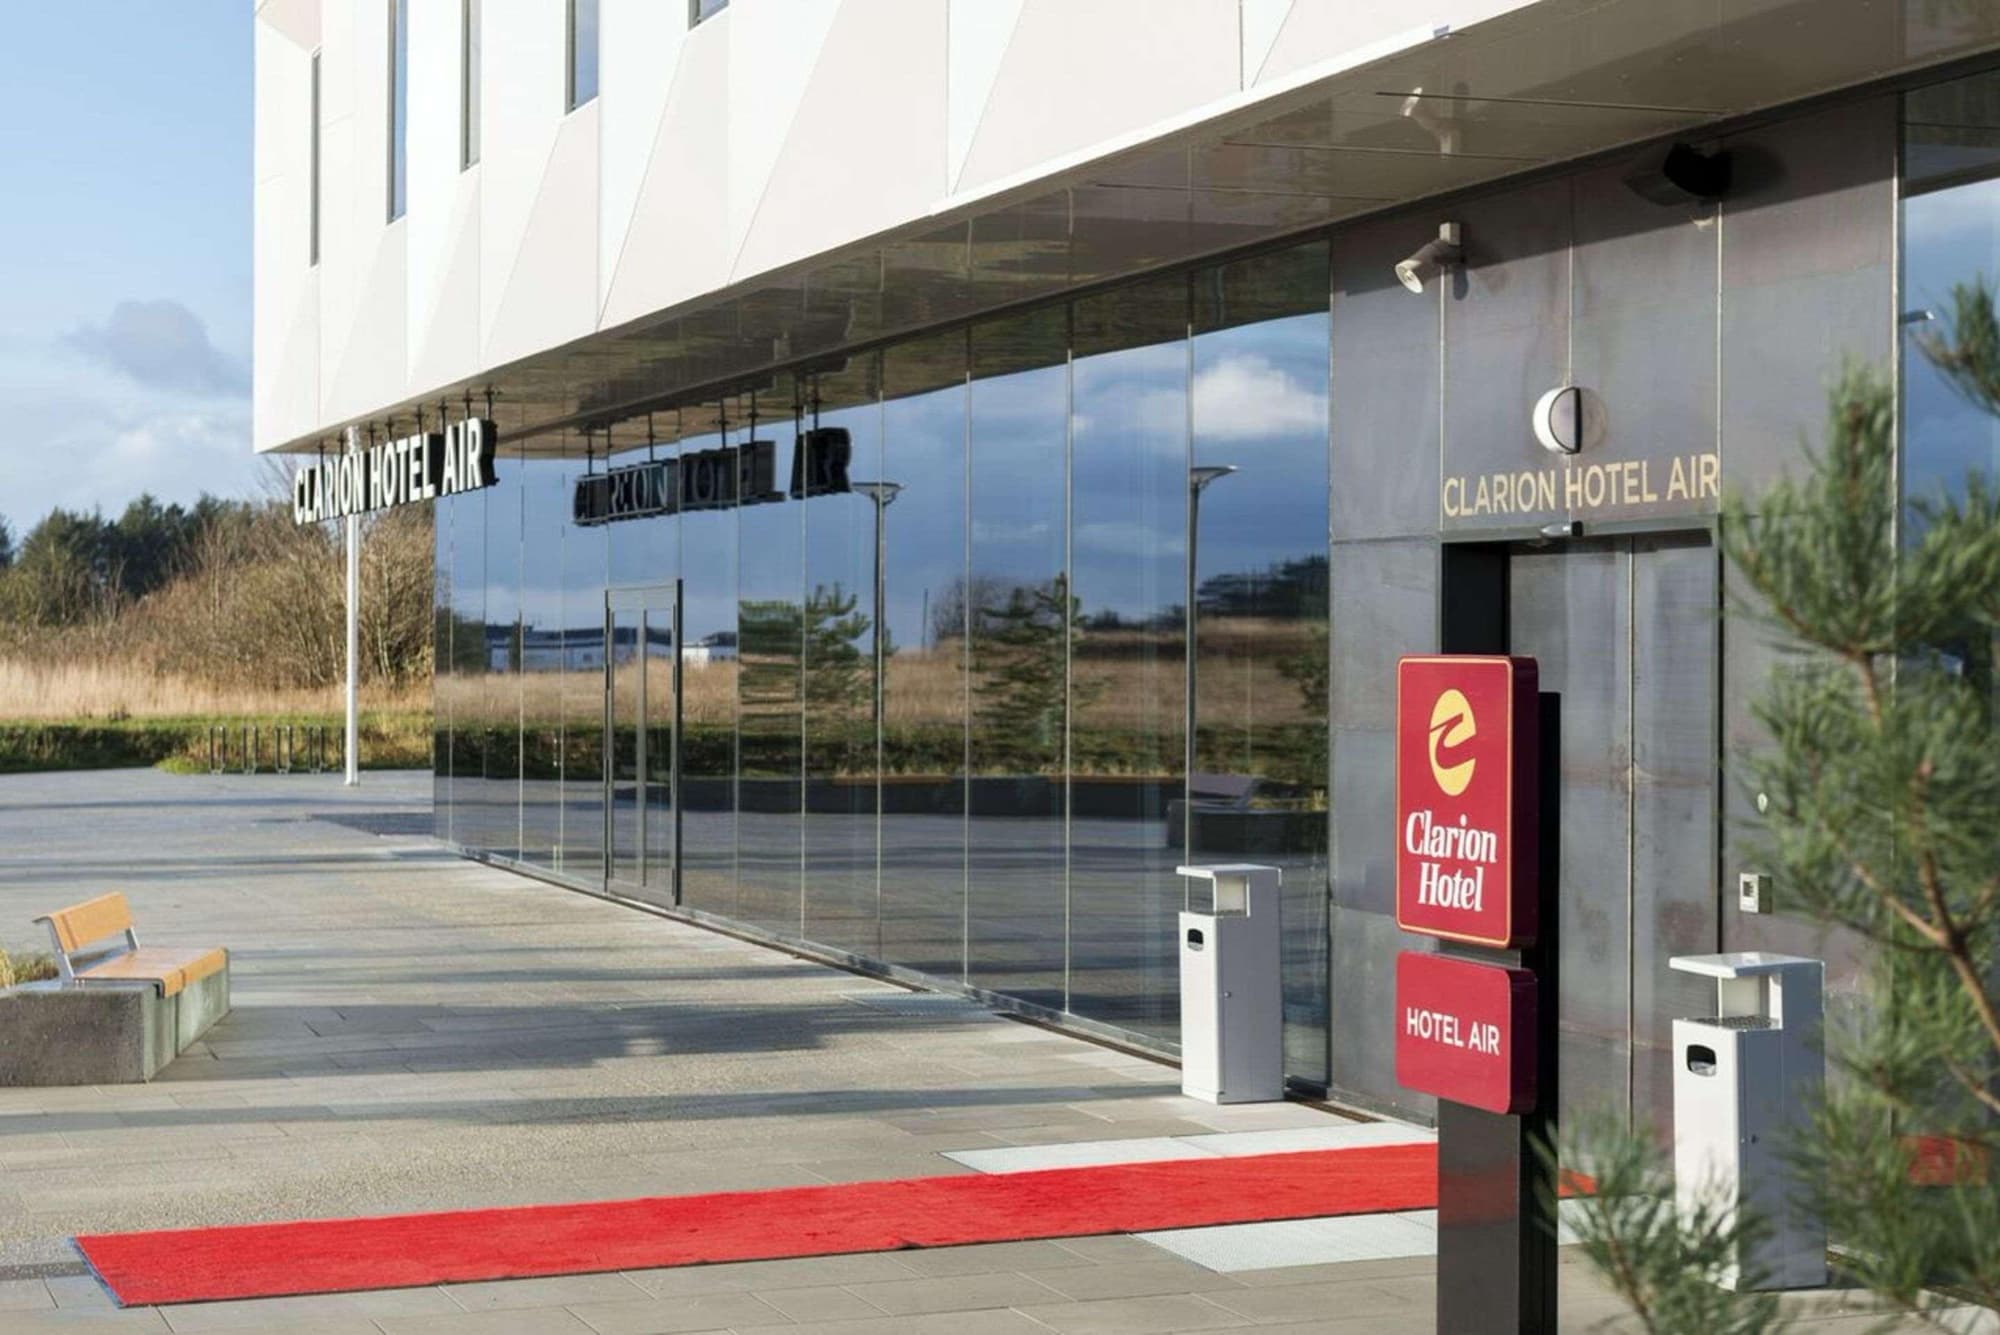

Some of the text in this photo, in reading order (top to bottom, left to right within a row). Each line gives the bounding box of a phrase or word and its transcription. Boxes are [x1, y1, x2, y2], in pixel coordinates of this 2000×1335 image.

[294, 451, 364, 525] CLARION
[370, 431, 436, 509] HOTEL
[442, 417, 483, 496] AIR
[1443, 453, 1720, 517] CLARION HOTEL AIR
[1405, 810, 1498, 864] Clarion
[1418, 862, 1483, 911] Hotel
[1406, 1006, 1500, 1056] HOTEL AIR
